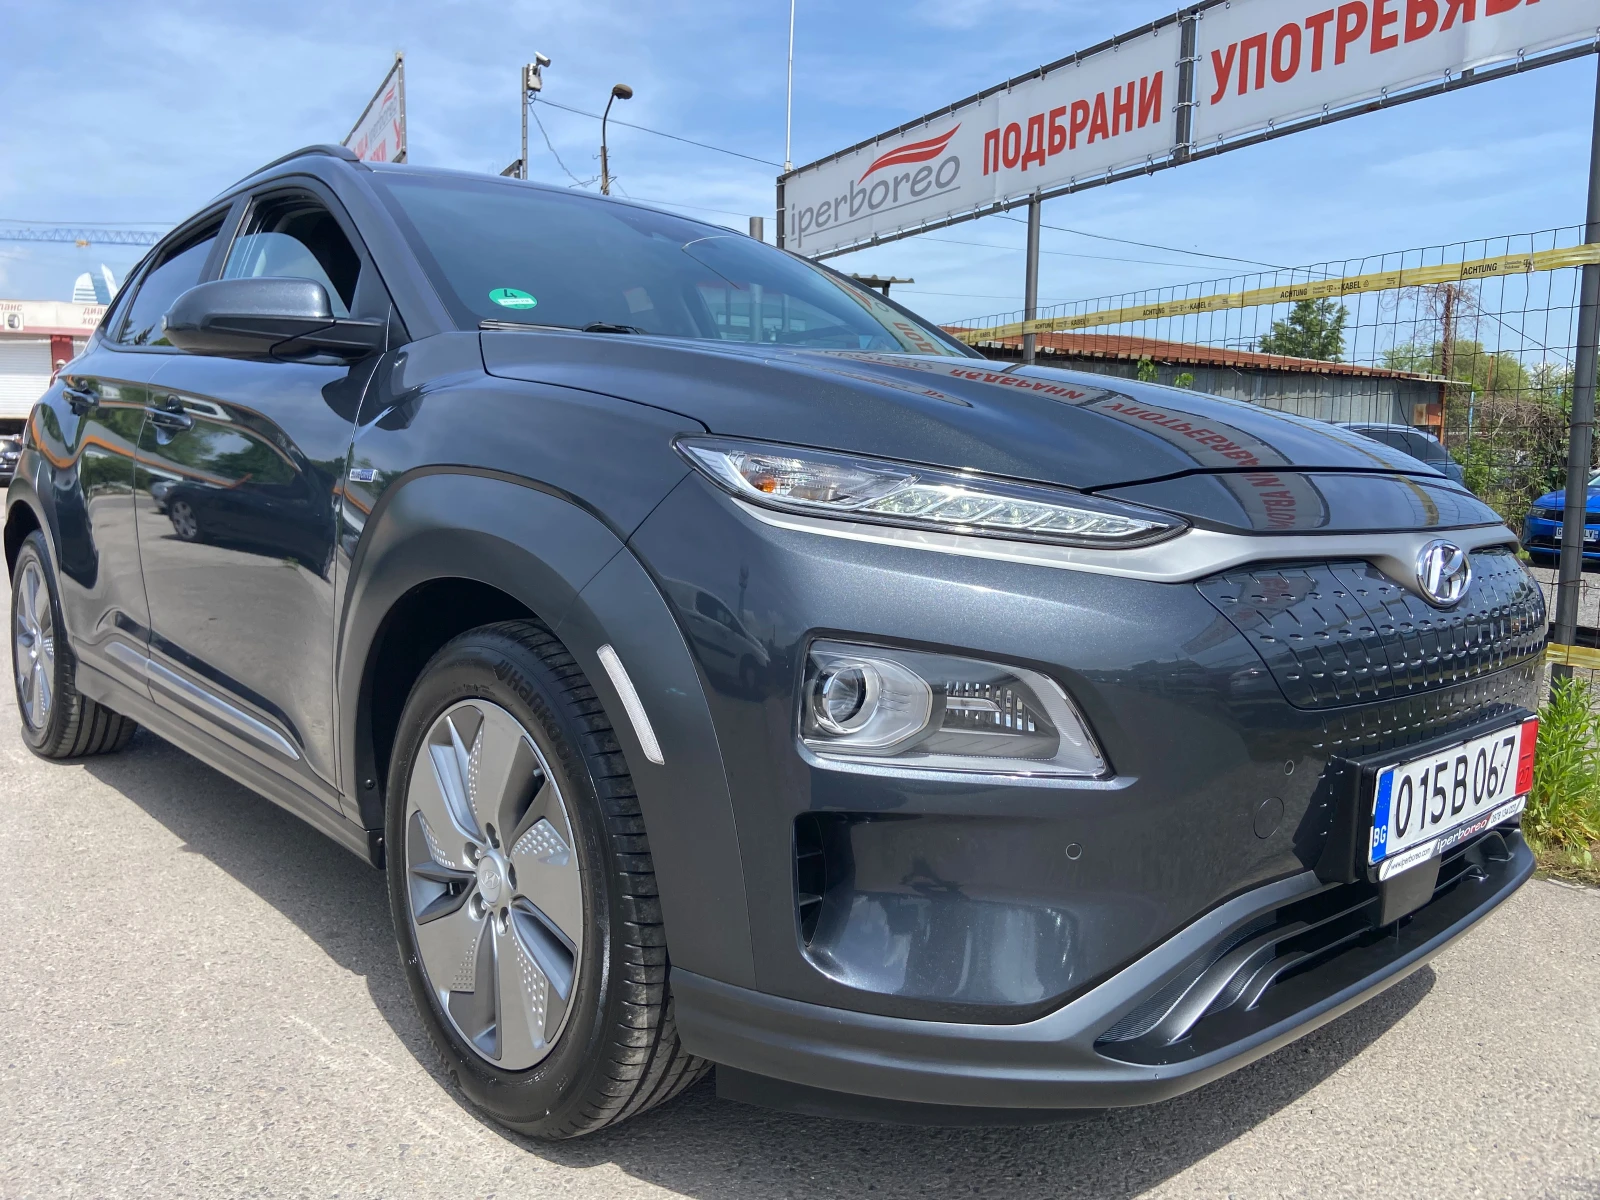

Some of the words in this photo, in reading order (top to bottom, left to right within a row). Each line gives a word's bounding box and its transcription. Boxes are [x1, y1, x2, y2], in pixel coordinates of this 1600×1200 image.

[983, 71, 1163, 176] ПОДБРАНИ
[1210, 0, 1541, 106] УПОТРЕБ
[791, 155, 961, 248] iperboreo
[1463, 263, 1497, 275] ACHTUNG
[504, 289, 517, 298] 4
[1280, 288, 1307, 298] ACHTUNG
[1341, 281, 1361, 291] KABEL
[1143, 307, 1165, 316] ACHTUNG
[1189, 302, 1206, 310] KABEL
[1395, 735, 1515, 839] 015B067
[1373, 825, 1388, 848] BG
[1437, 819, 1488, 853] iperboreo
